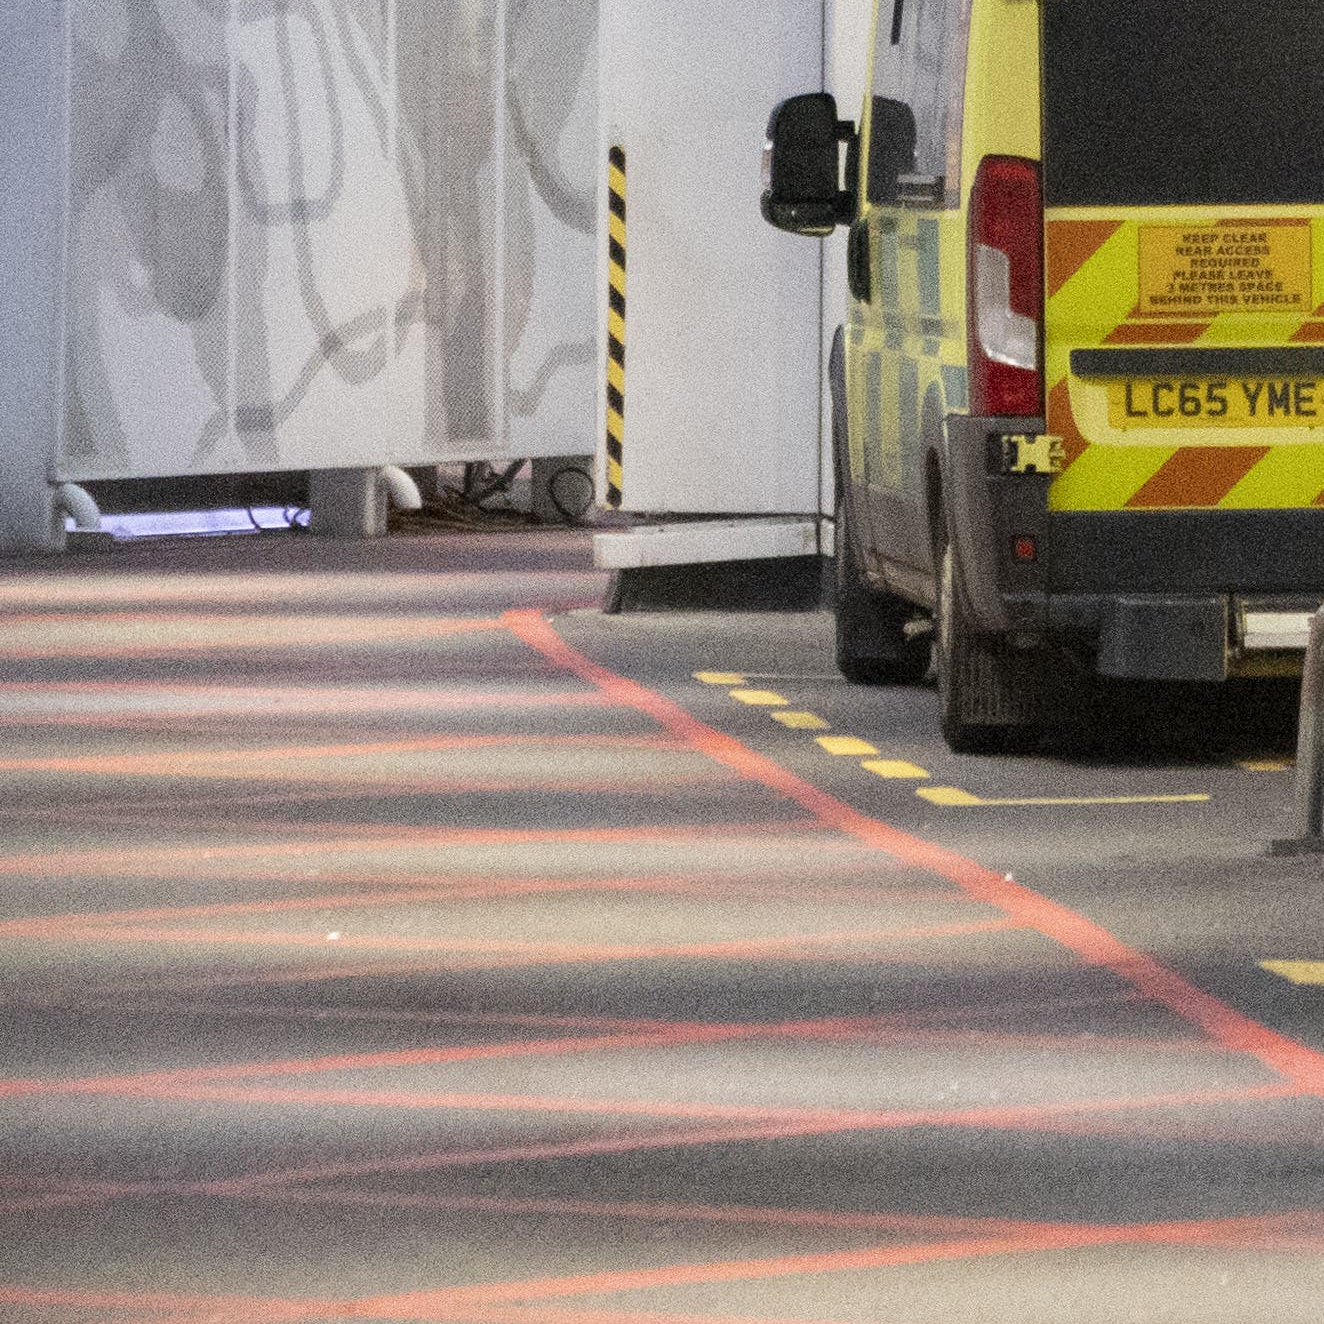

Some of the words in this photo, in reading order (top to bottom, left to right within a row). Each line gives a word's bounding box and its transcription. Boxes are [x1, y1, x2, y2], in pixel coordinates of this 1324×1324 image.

[1182, 232, 1218, 244] KEEP
[1223, 232, 1267, 244] CLEAR
[1175, 245, 1211, 256] REAR
[1216, 245, 1270, 256] ACCESS
[1190, 257, 1260, 268] REQUIRED
[1173, 269, 1224, 280] PLEASE
[1229, 268, 1273, 280] LEAVE
[1179, 282, 1234, 292] METRES
[1239, 281, 1283, 292] SPACE
[1150, 295, 1201, 305] BEHIND
[1207, 294, 1237, 304] THIS
[1243, 293, 1301, 304] VEHICLE
[1125, 382, 1228, 418] LC65
[1240, 381, 1317, 417] YME
